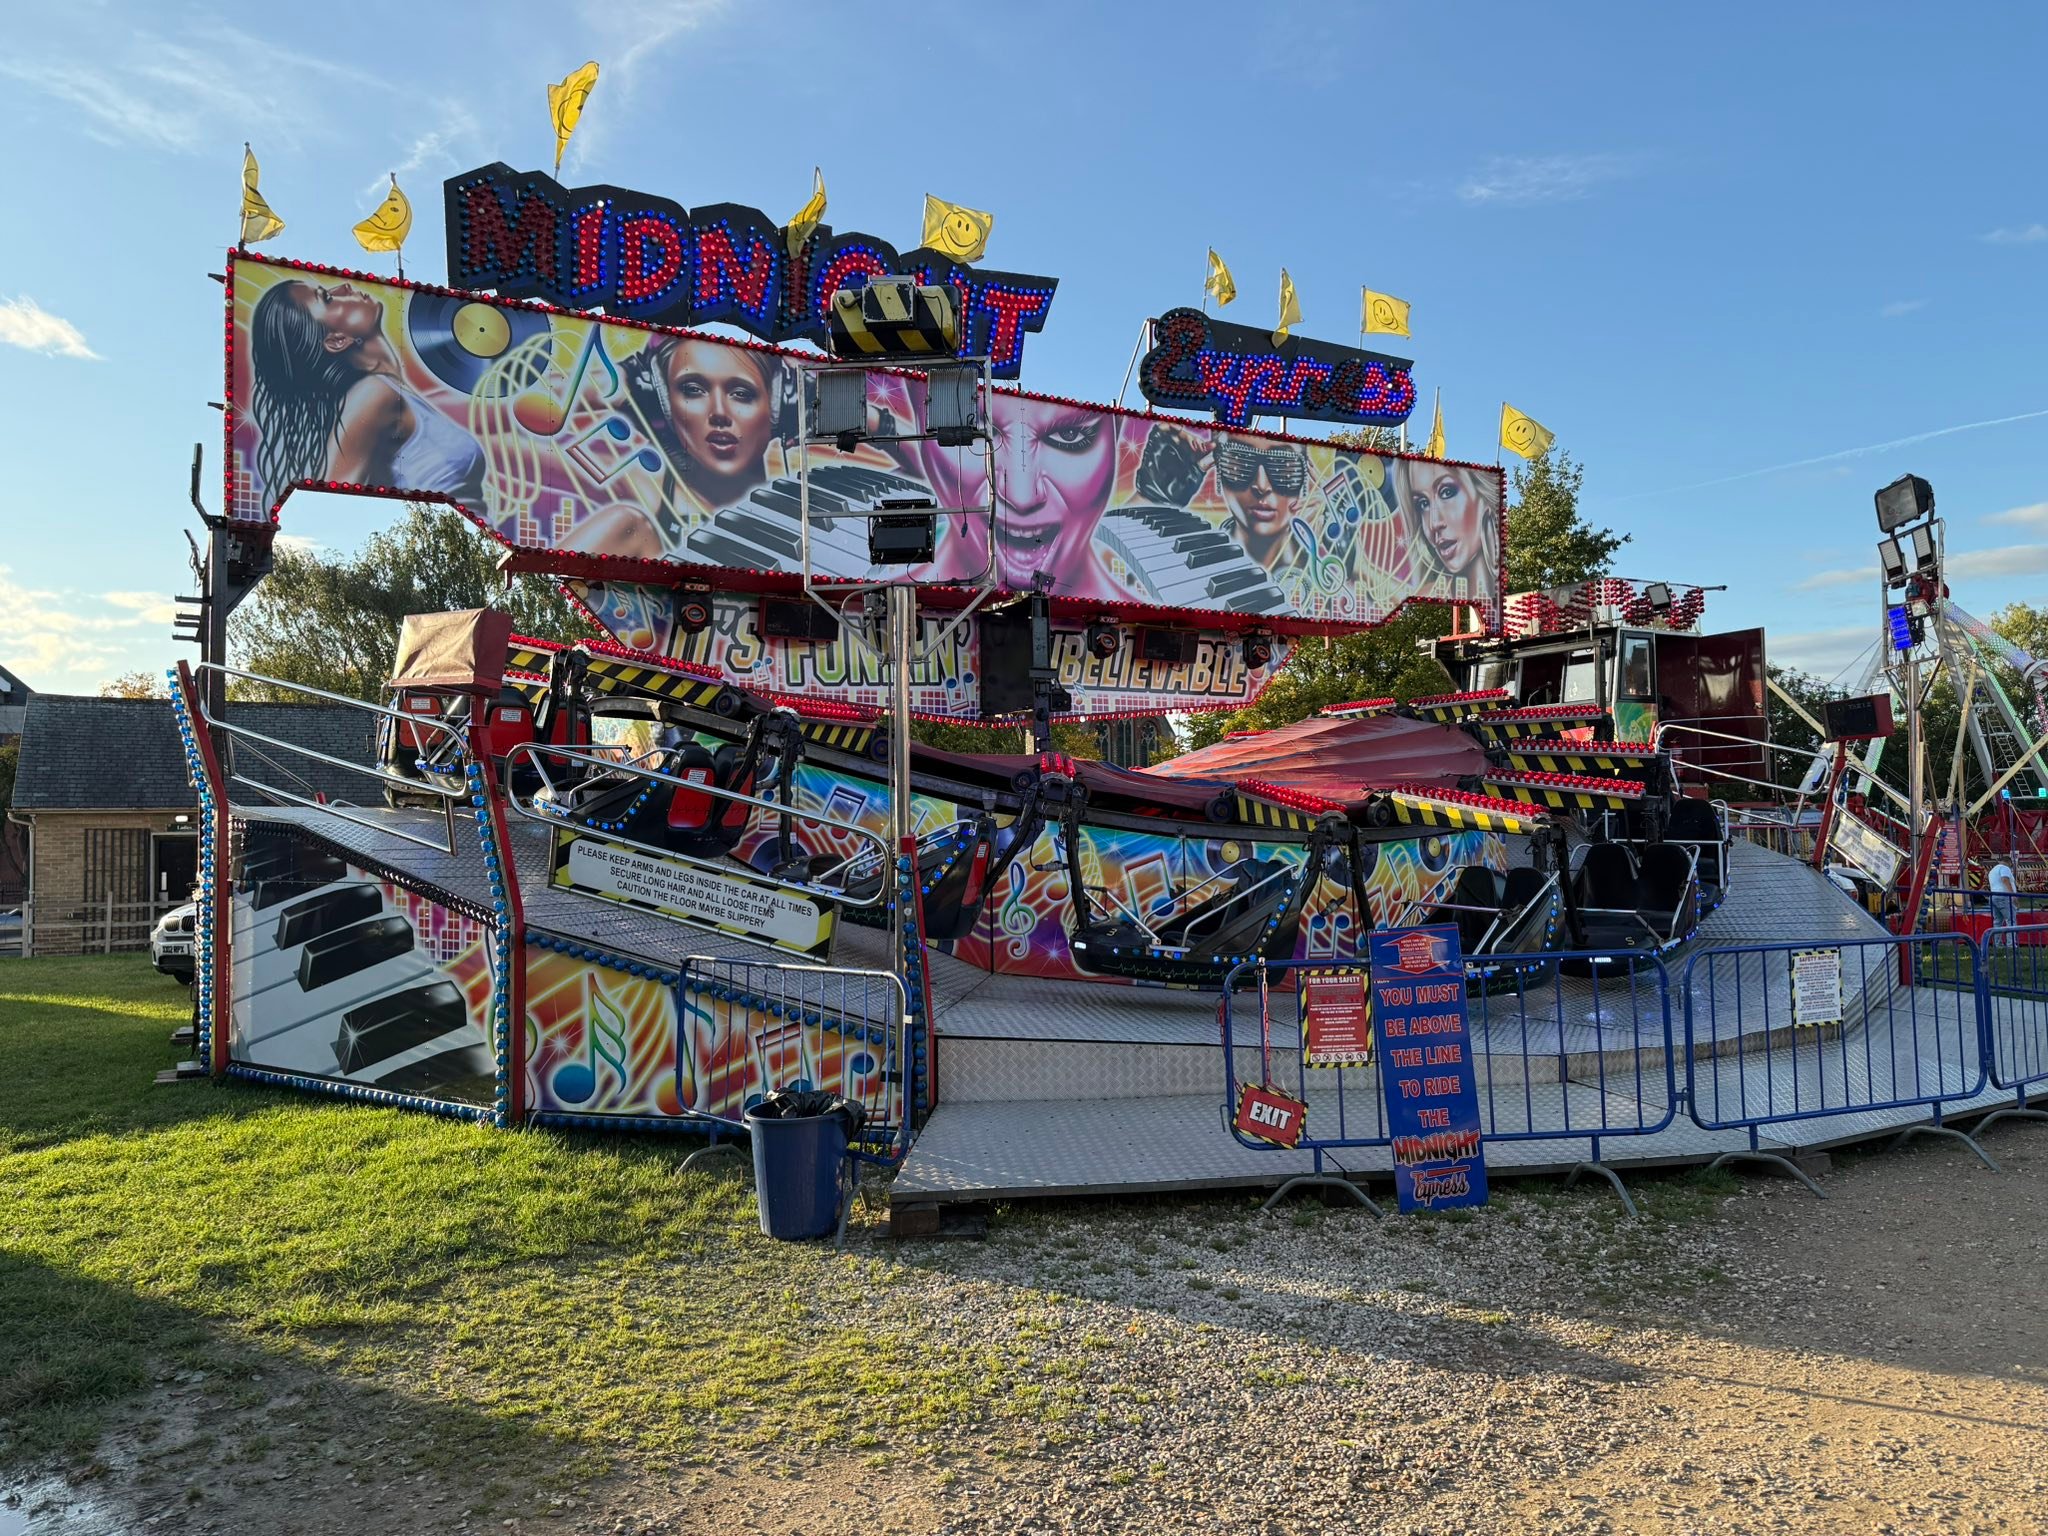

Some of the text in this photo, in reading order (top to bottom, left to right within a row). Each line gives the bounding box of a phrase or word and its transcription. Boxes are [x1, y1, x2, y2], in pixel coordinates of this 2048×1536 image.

[577, 845, 812, 917] PLEASE KEEP ARMS AND LEGS INSIDE THE CAR AT ALL TIMES
[610, 866, 775, 919] SECURE LONG HAIR AND ALL LOOSE ITEMS
[617, 880, 766, 929] CAUTION THE FLOOR MAYBE SLIPPERY
[1338, 976, 1360, 984] SAFETY
[1380, 988, 1413, 1008] YOU
[1415, 983, 1460, 1004] MUST
[1384, 1013, 1462, 1038] BE ABOVE
[1390, 1045, 1462, 1068] THE LINE
[1398, 1075, 1461, 1098] TO RIDE
[1249, 1099, 1294, 1132] EXIT
[1417, 1107, 1450, 1128] THE
[1392, 1129, 1480, 1167] MIDNIGHT
